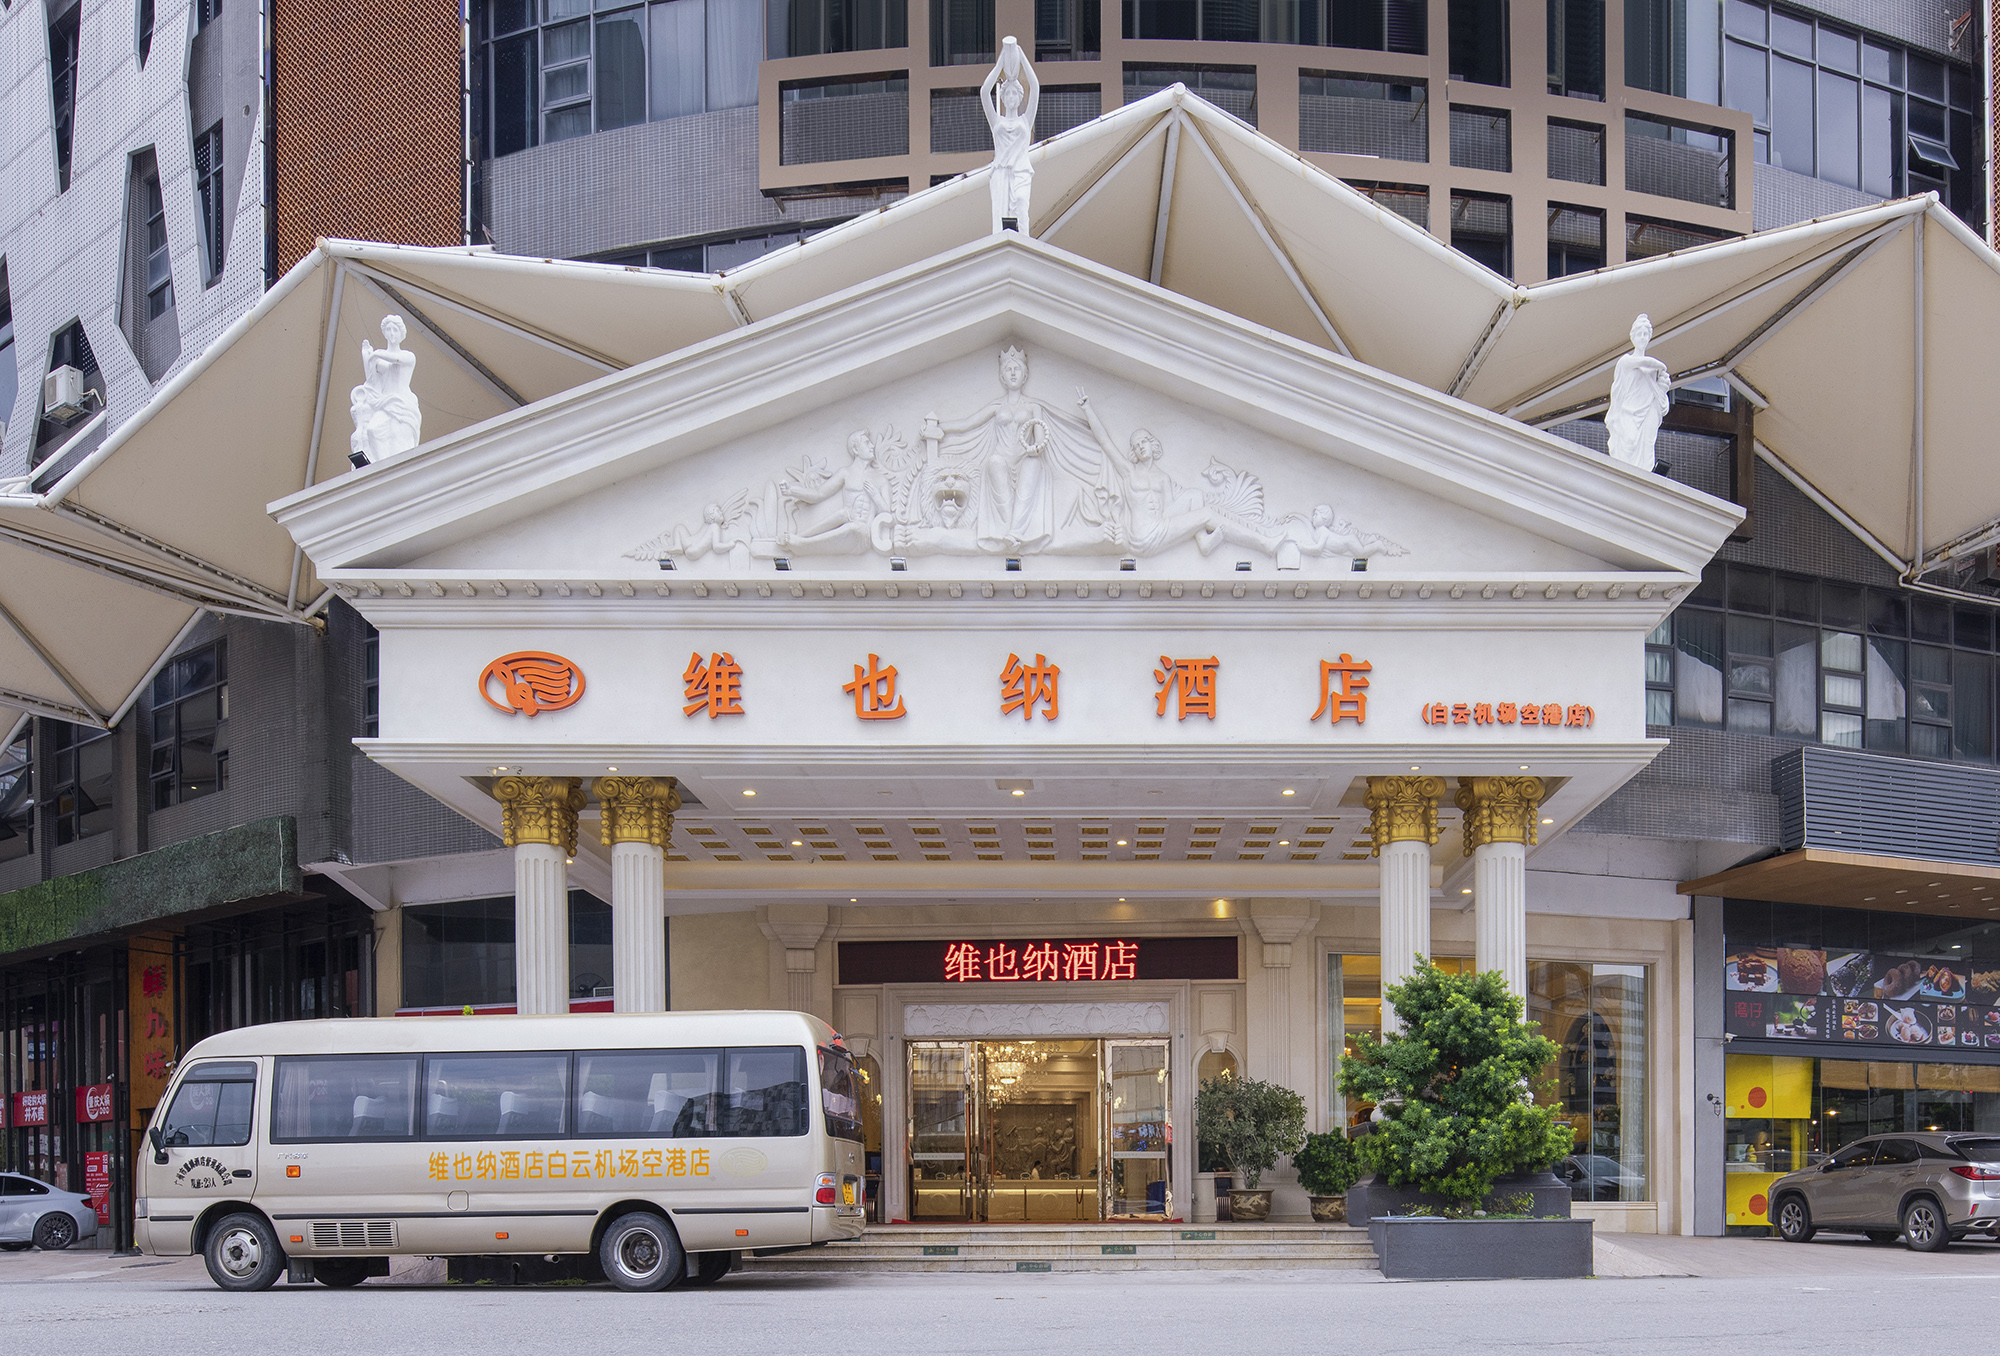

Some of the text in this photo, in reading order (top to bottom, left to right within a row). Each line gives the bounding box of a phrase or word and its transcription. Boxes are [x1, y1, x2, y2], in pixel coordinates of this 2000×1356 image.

[683, 651, 1372, 724] 维也纳酒店
[1422, 701, 1595, 728] (白云机场空港店)
[944, 940, 1138, 982] 维也纳酒店
[143, 965, 167, 1079] 鲜九味
[1734, 1001, 1762, 1018] 湾仔
[88, 1094, 110, 1107] 重庆火锅
[428, 1148, 710, 1181] 维也纳酒店白云机场空港店
